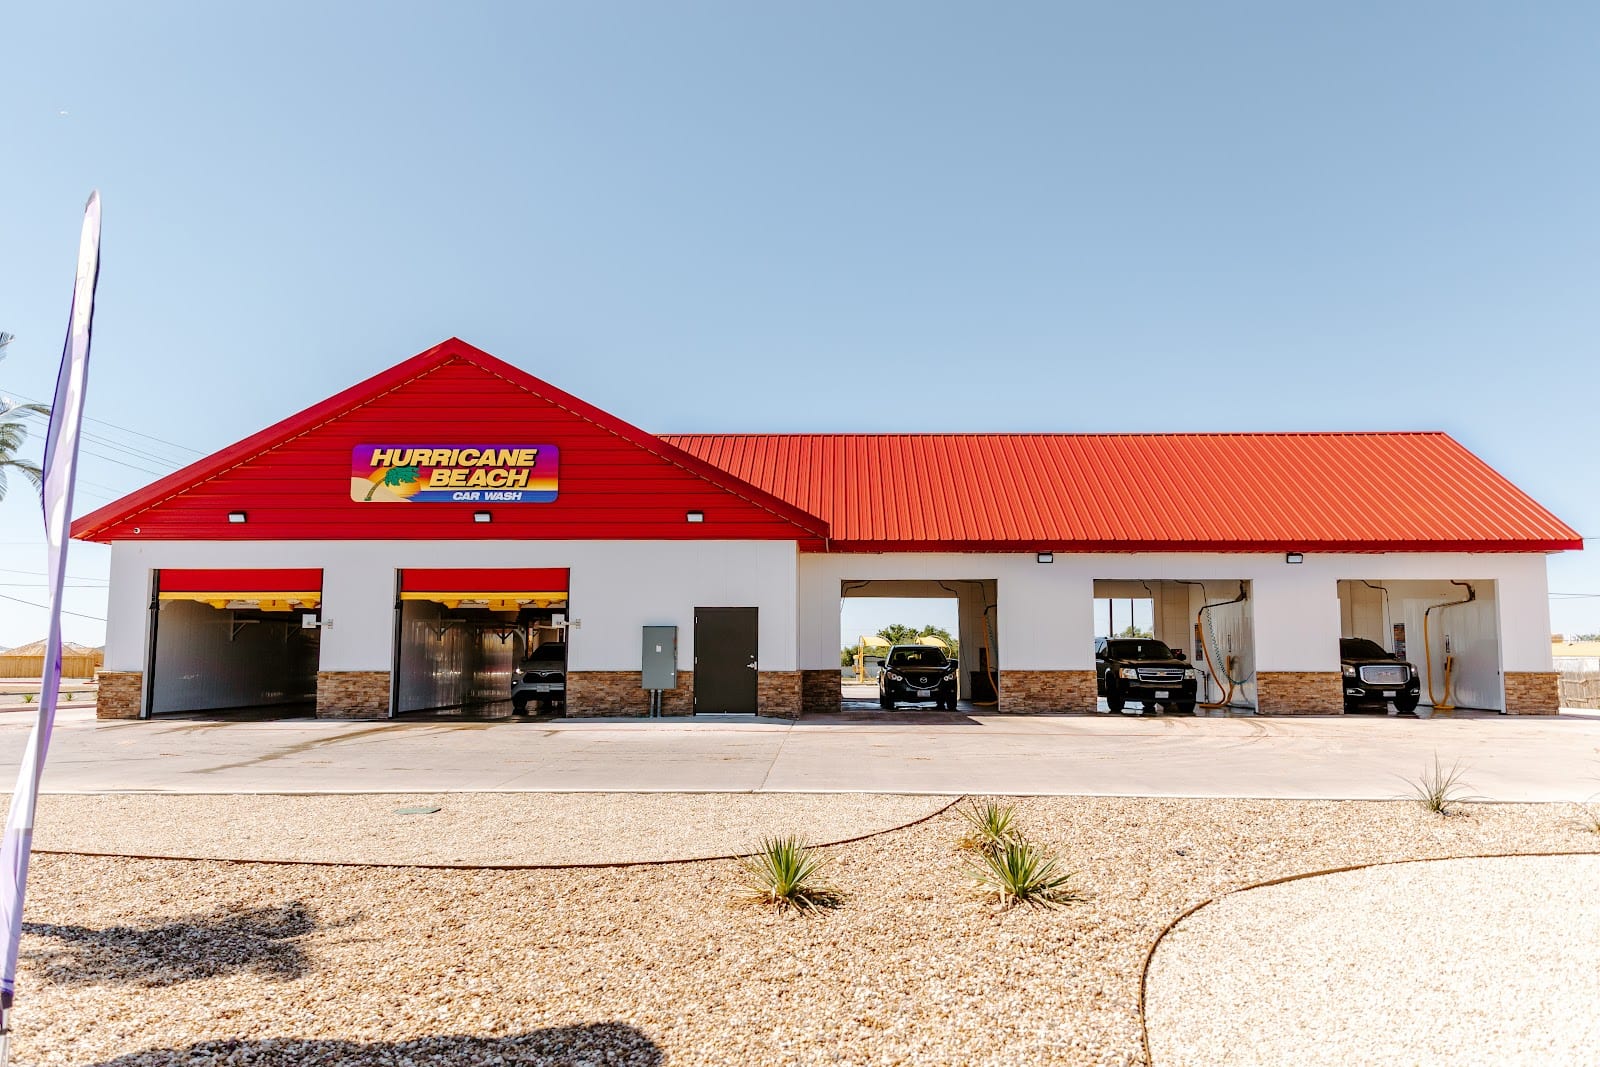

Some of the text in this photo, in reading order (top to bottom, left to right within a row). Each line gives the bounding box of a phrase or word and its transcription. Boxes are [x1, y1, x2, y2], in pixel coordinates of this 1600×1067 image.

[370, 448, 537, 467] HURRICANE
[429, 469, 529, 487] BEACH
[452, 491, 523, 501] CAR WASH
